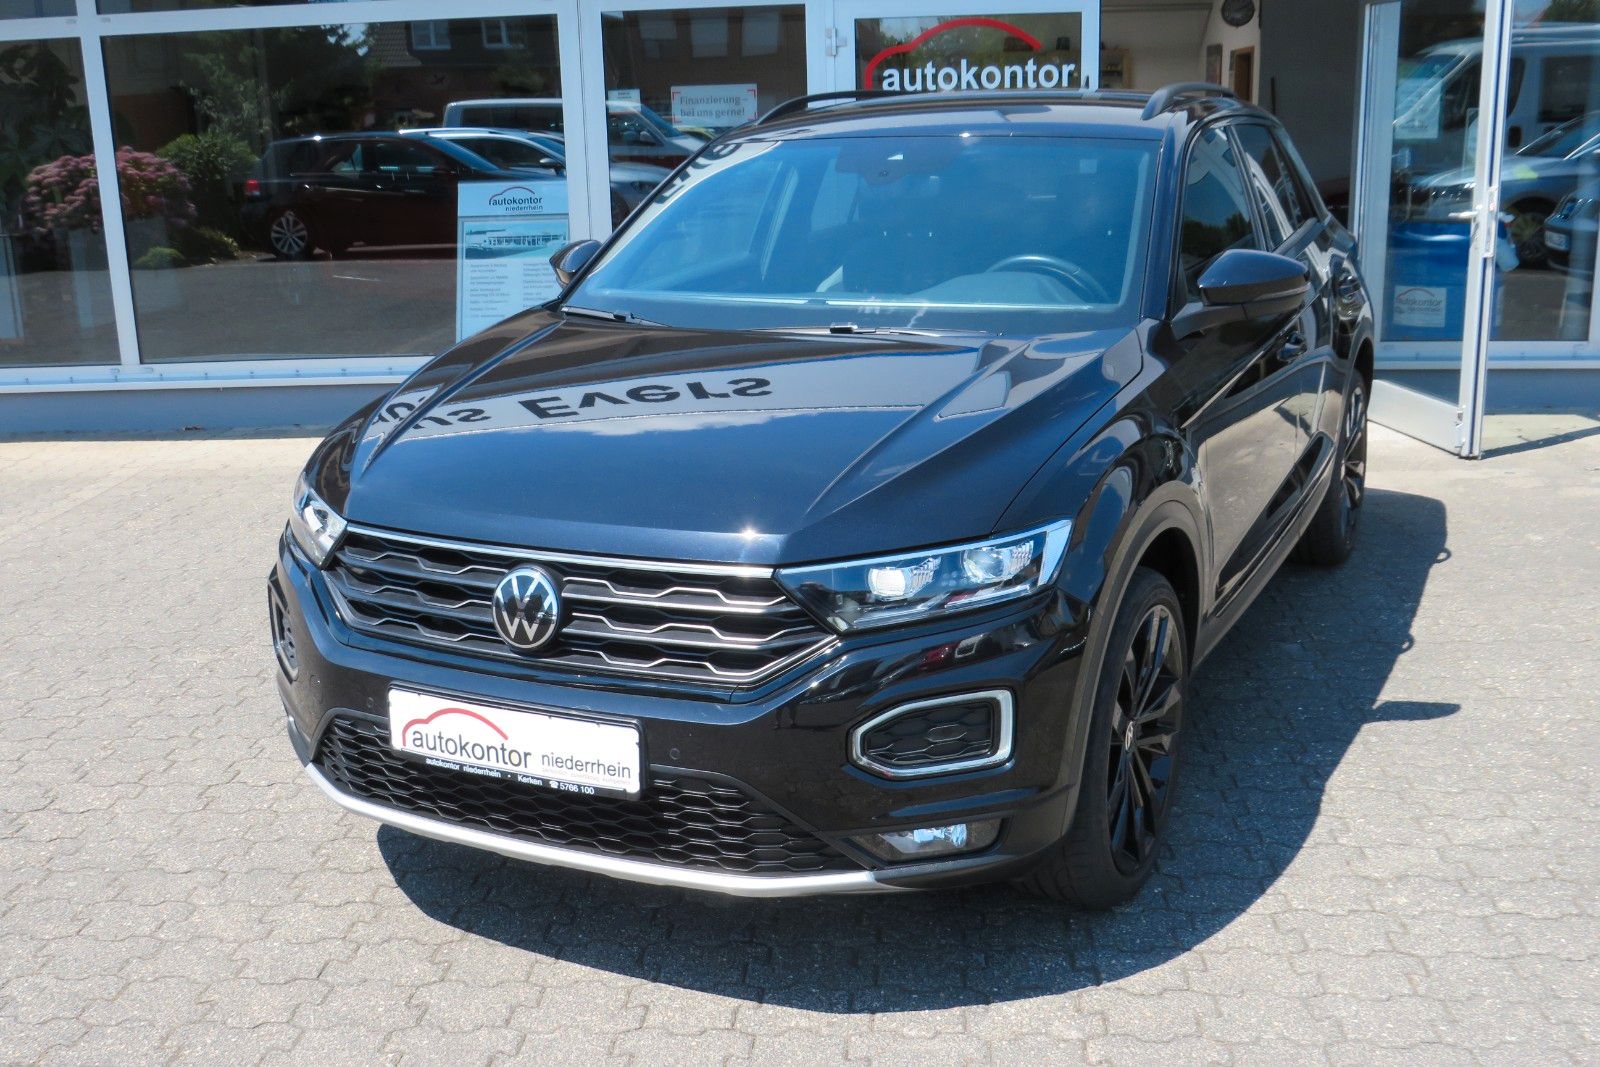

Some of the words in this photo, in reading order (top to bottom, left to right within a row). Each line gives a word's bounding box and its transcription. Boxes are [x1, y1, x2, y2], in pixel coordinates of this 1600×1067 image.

[882, 57, 1076, 92] autokontor
[679, 95, 741, 106] Finanzierung
[680, 109, 694, 118] bei
[695, 110, 712, 118] uns
[492, 196, 543, 206] autokontor
[506, 203, 543, 212] niederrhein
[411, 730, 532, 769] autokontor
[541, 751, 631, 779] niederrhein
[426, 757, 460, 771] autokontor
[463, 764, 501, 778] niederrhein
[517, 773, 543, 786] Kerken
[580, 785, 595, 795] 100
